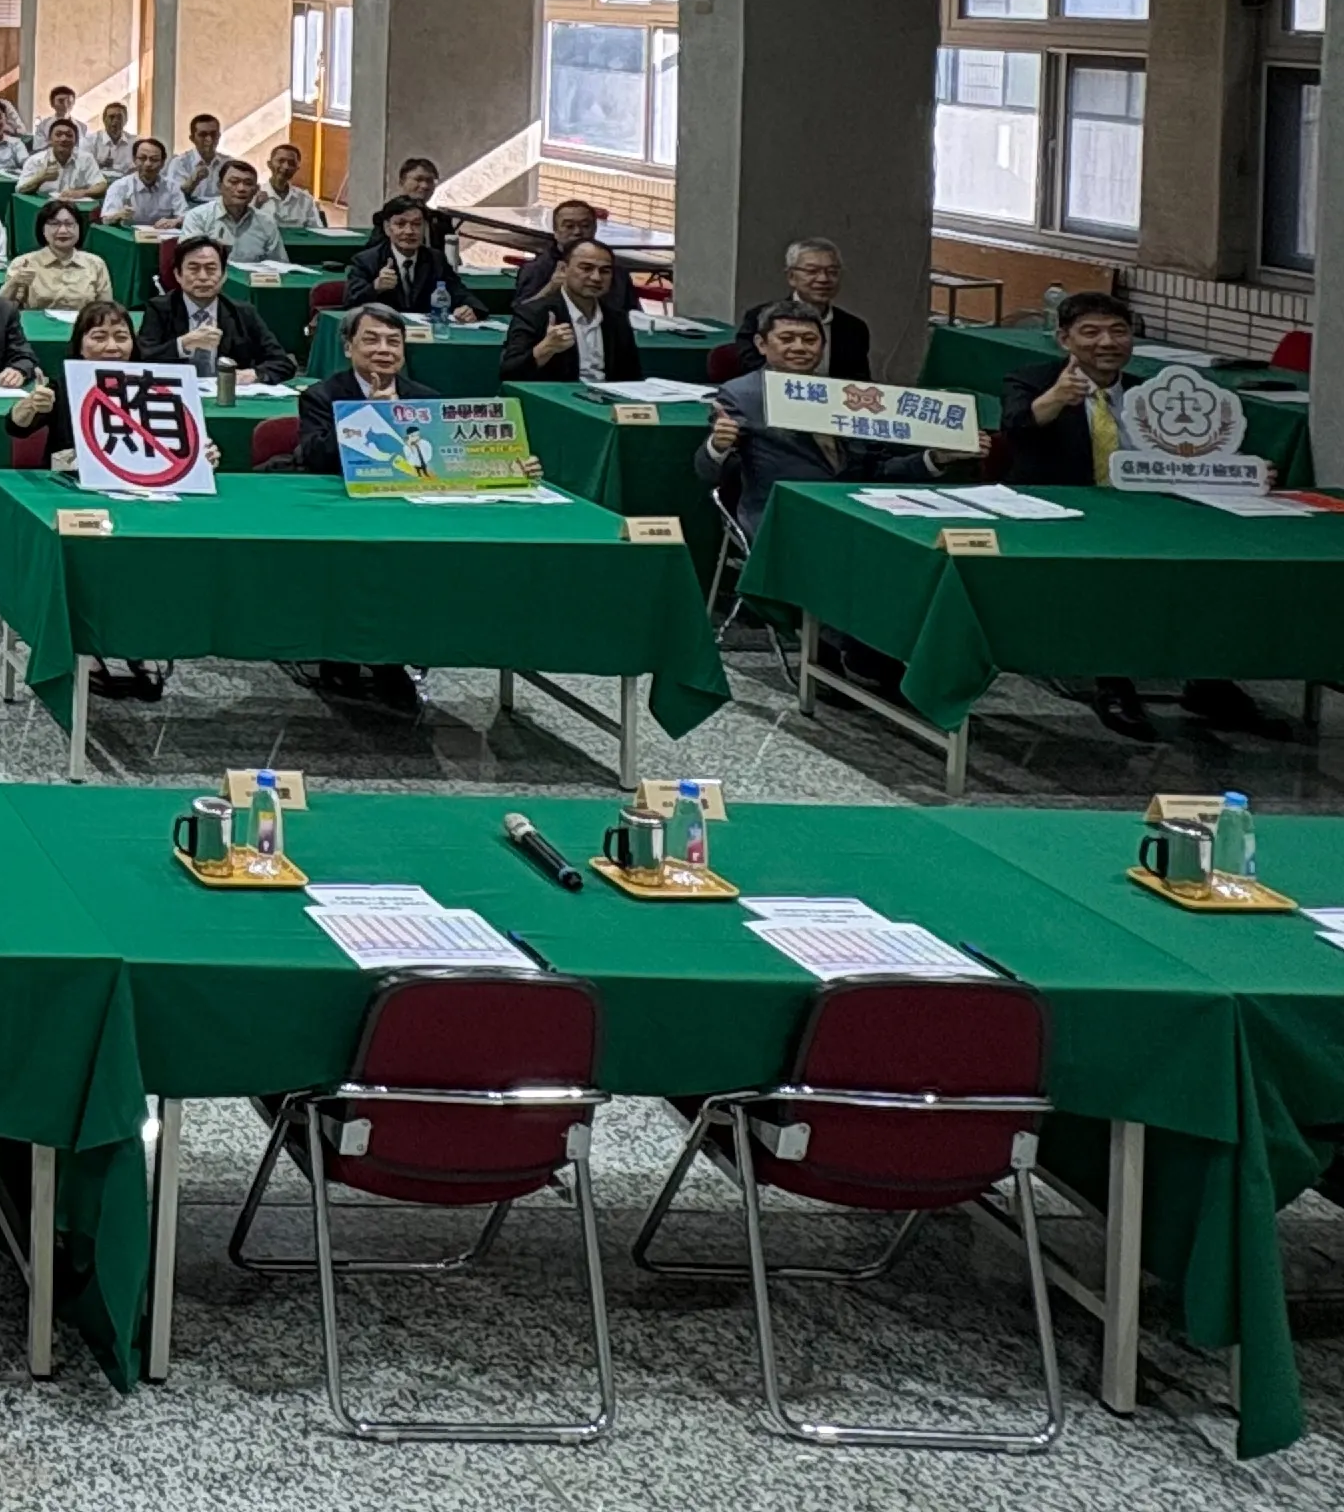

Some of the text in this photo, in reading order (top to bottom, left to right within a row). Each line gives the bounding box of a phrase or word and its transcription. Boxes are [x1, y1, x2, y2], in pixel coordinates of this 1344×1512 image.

[95, 369, 190, 460] 賄
[896, 391, 966, 430] 假訊息
